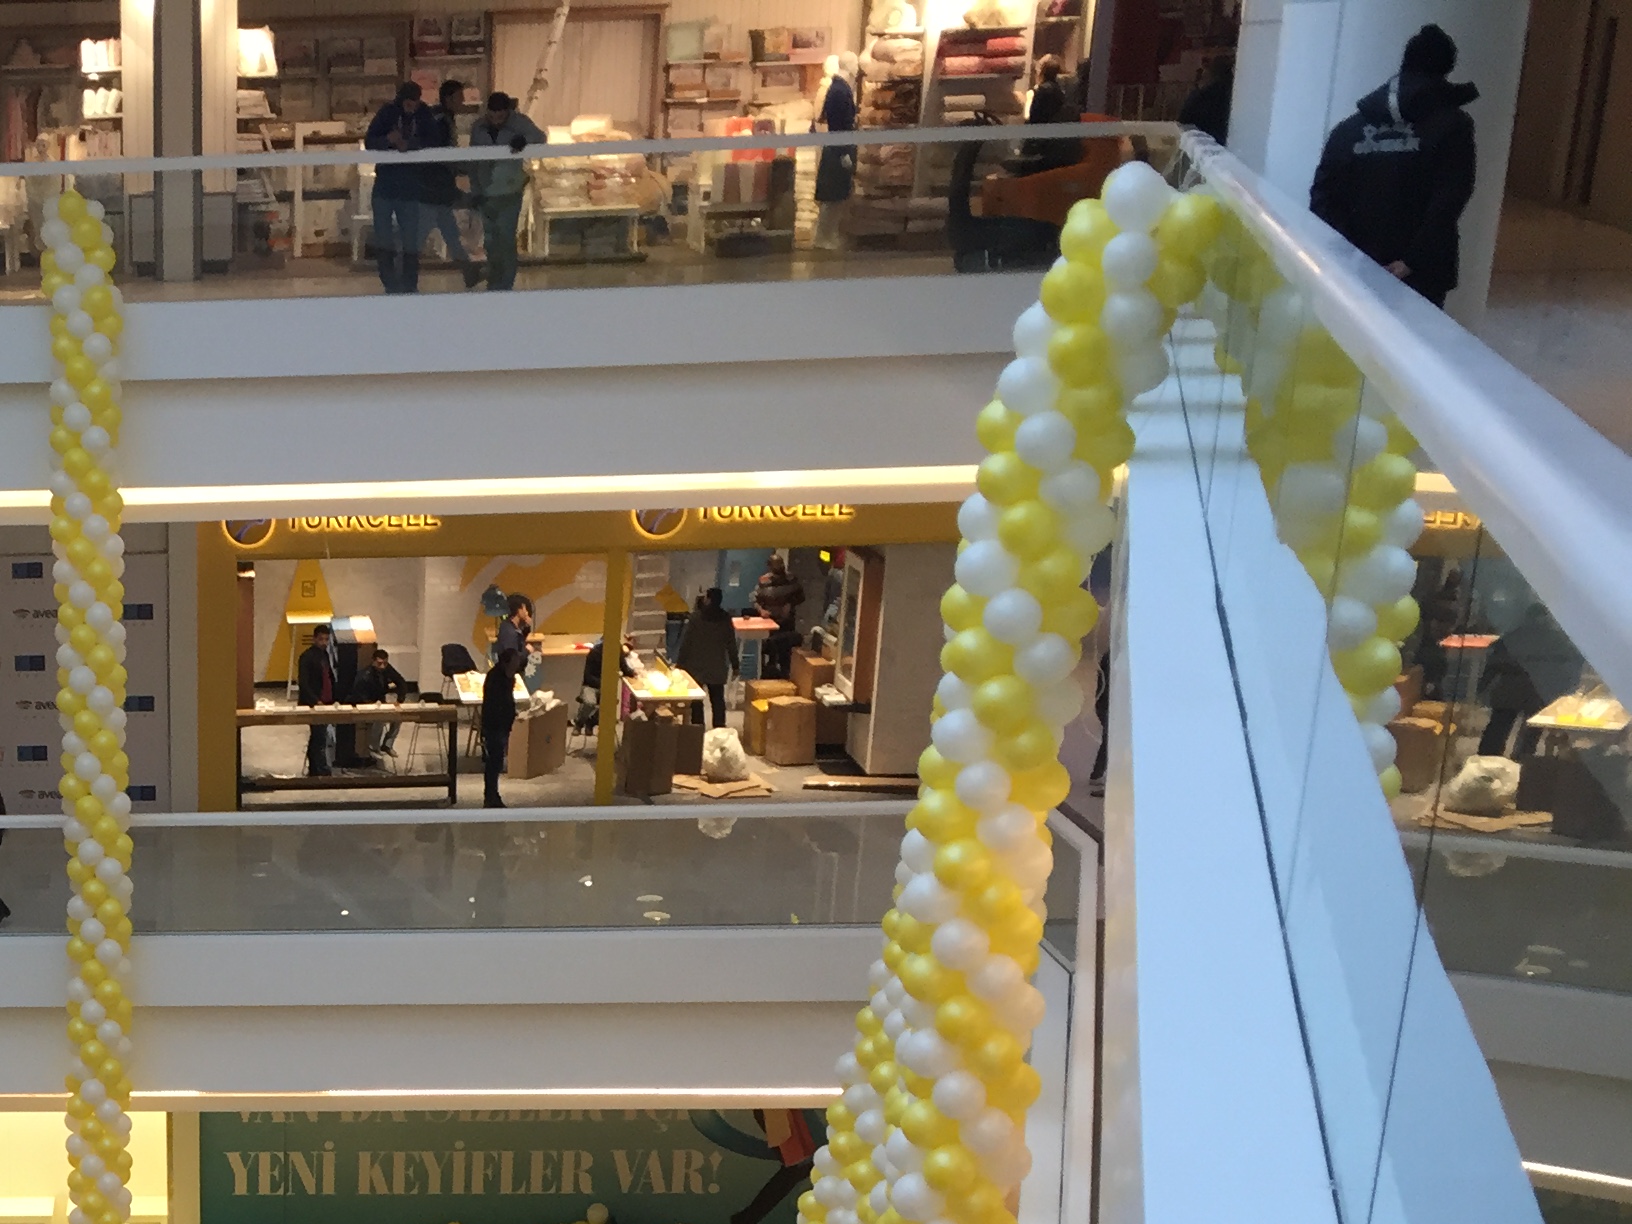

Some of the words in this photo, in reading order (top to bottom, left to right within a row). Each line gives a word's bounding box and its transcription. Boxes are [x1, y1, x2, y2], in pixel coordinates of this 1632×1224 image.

[224, 1140, 337, 1196] YENİ
[357, 1140, 594, 1195] KEYİFLER
[610, 1149, 724, 1195] VAR!
